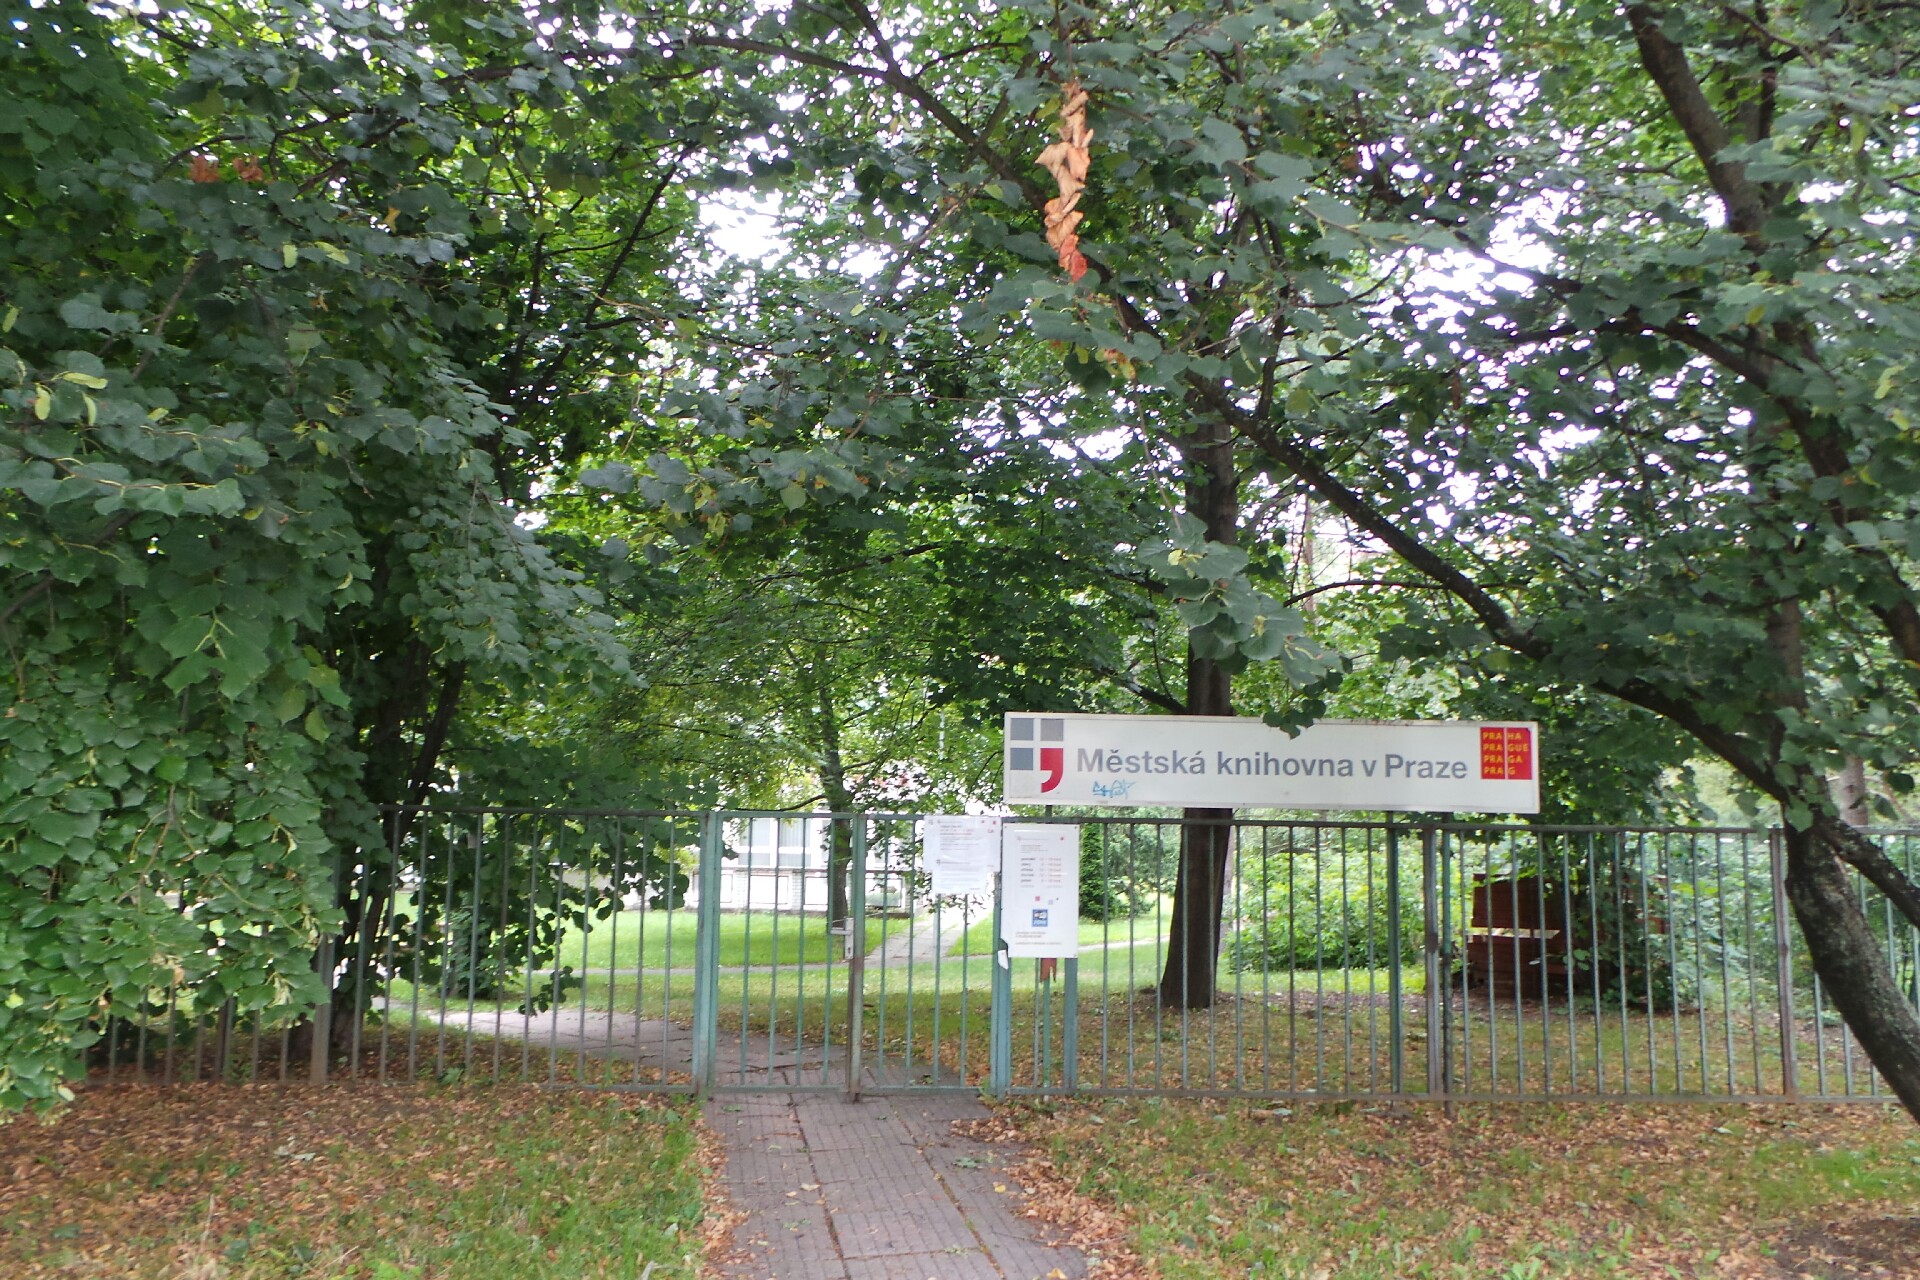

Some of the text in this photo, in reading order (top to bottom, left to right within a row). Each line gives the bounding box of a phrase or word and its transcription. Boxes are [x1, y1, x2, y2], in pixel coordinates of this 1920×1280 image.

[1077, 748, 1468, 780] Městská knihovna v Praze
